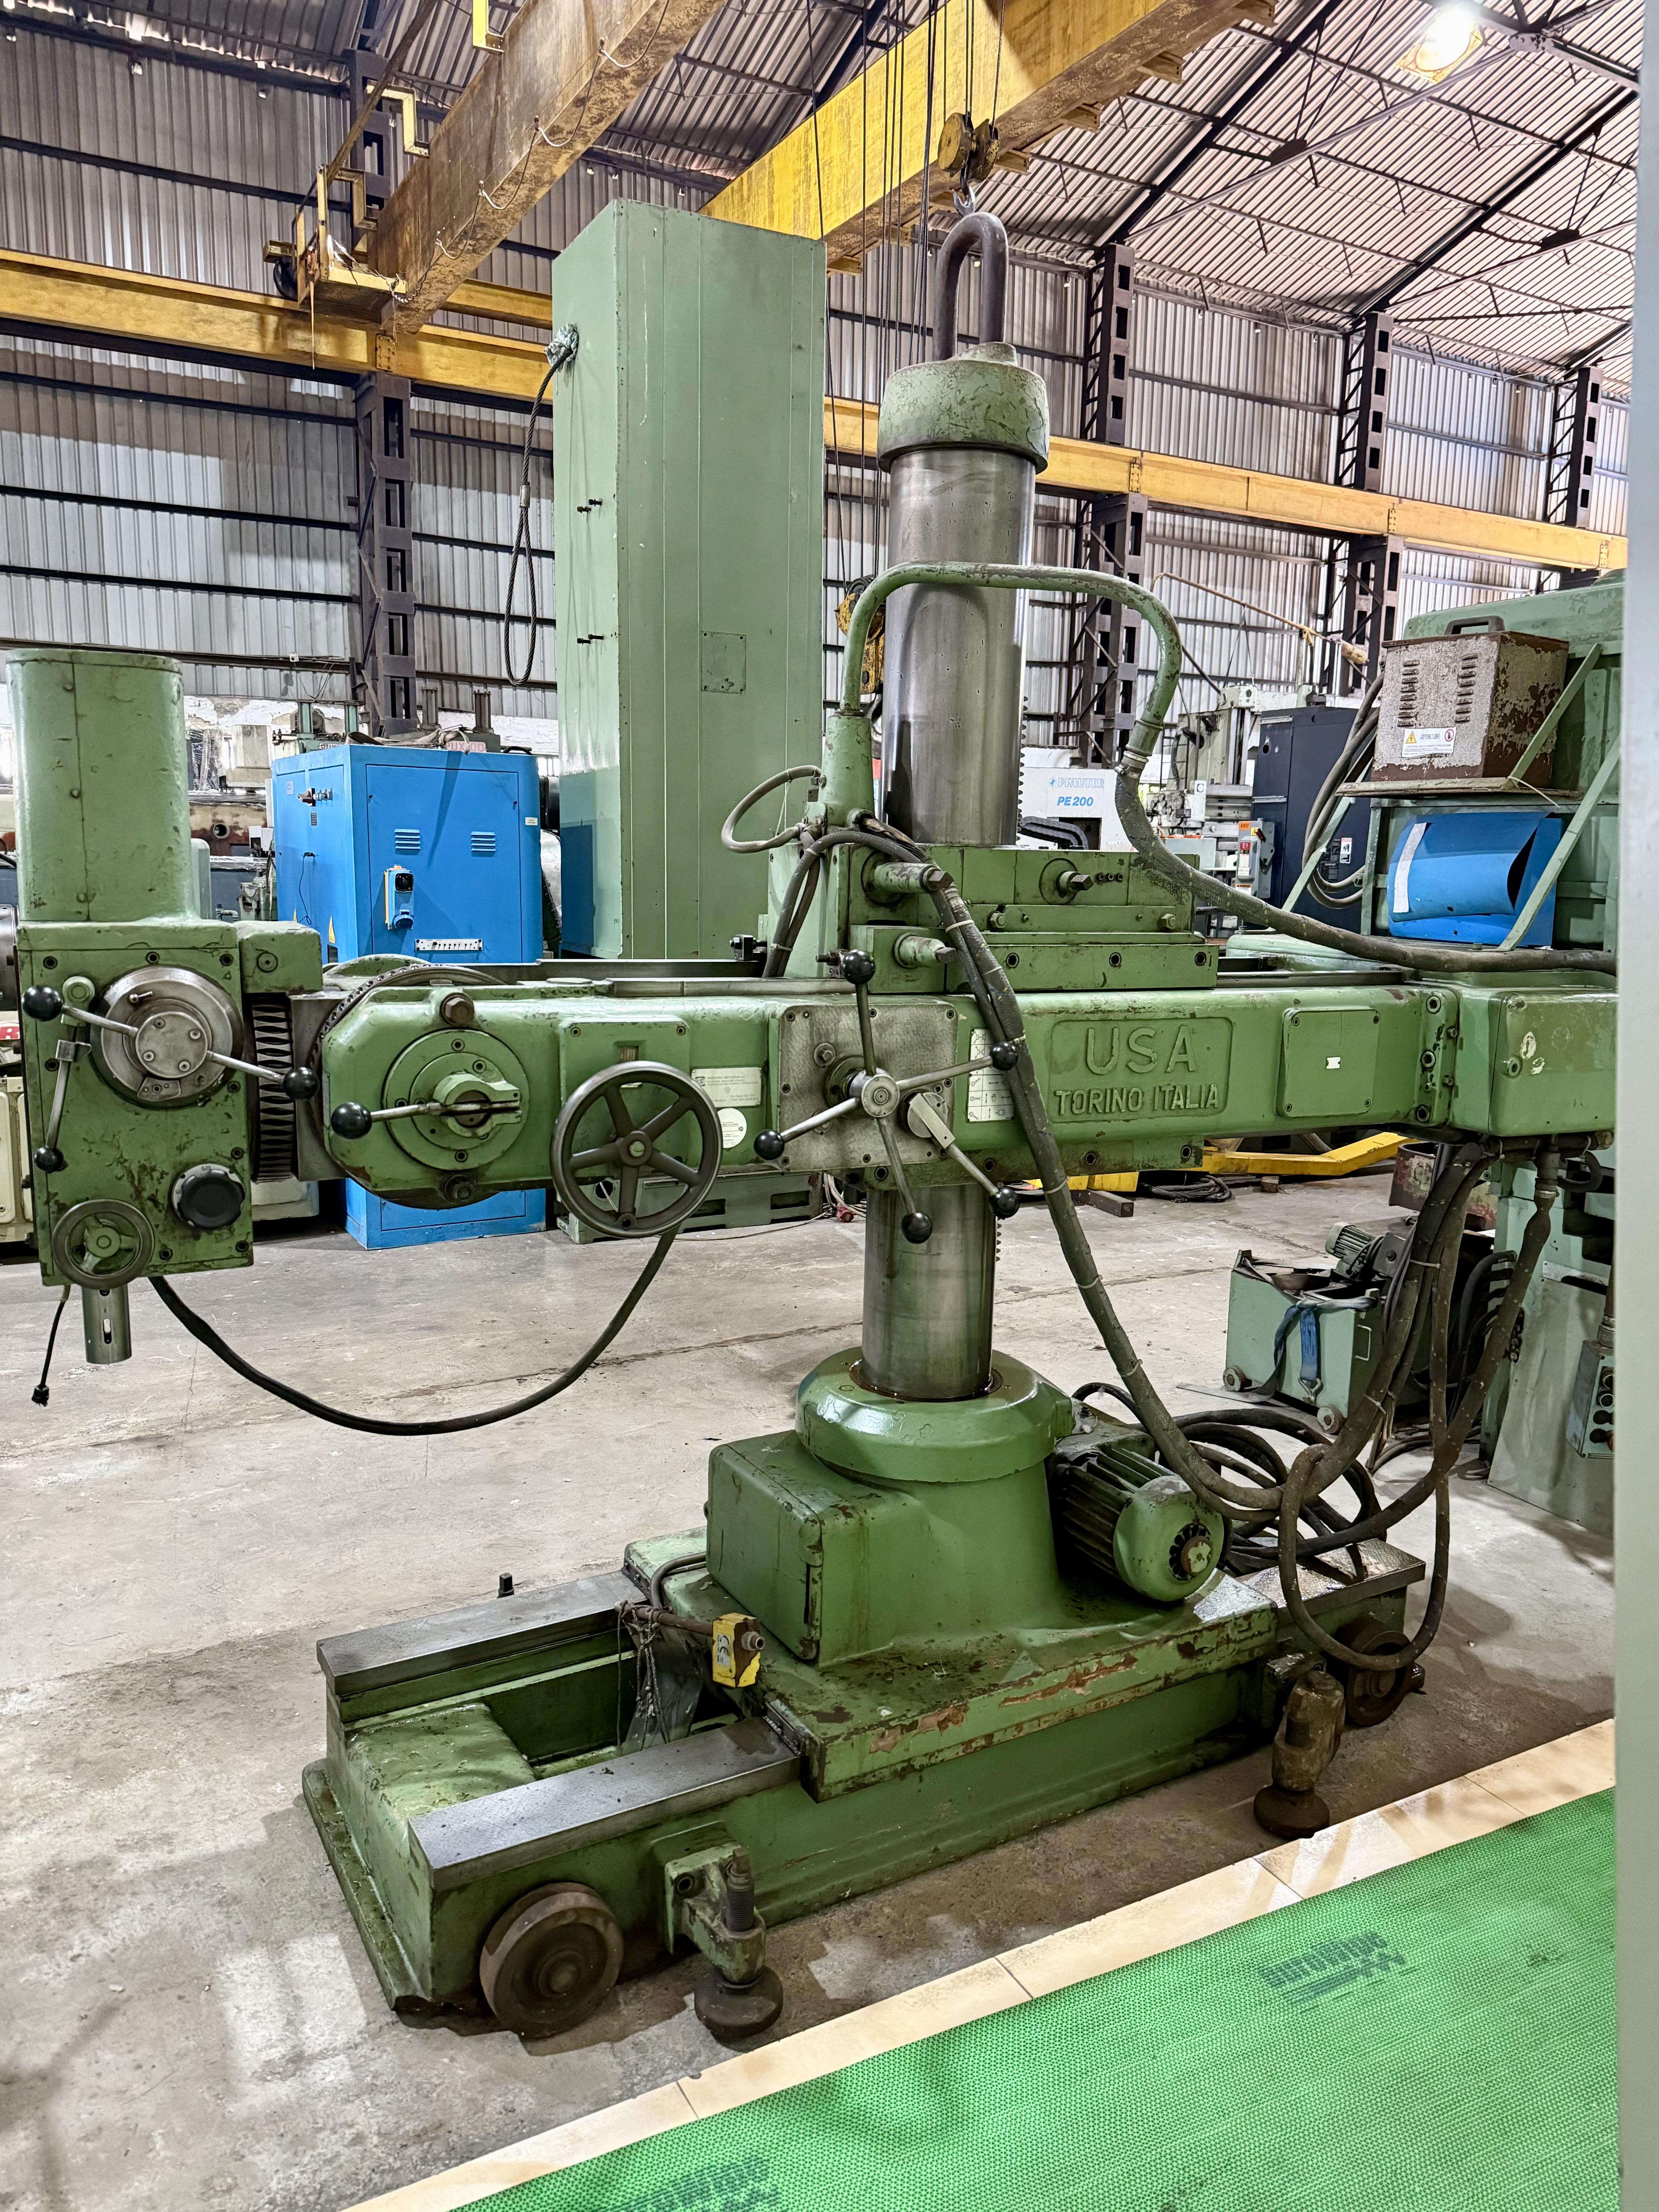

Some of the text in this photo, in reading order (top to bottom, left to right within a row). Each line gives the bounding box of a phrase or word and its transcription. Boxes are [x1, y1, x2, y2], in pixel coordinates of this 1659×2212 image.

[1058, 777, 1104, 788] PFAUTER
[1086, 1025, 1196, 1075] USA
[1054, 1083, 1219, 1116] TORINO ITALIA
